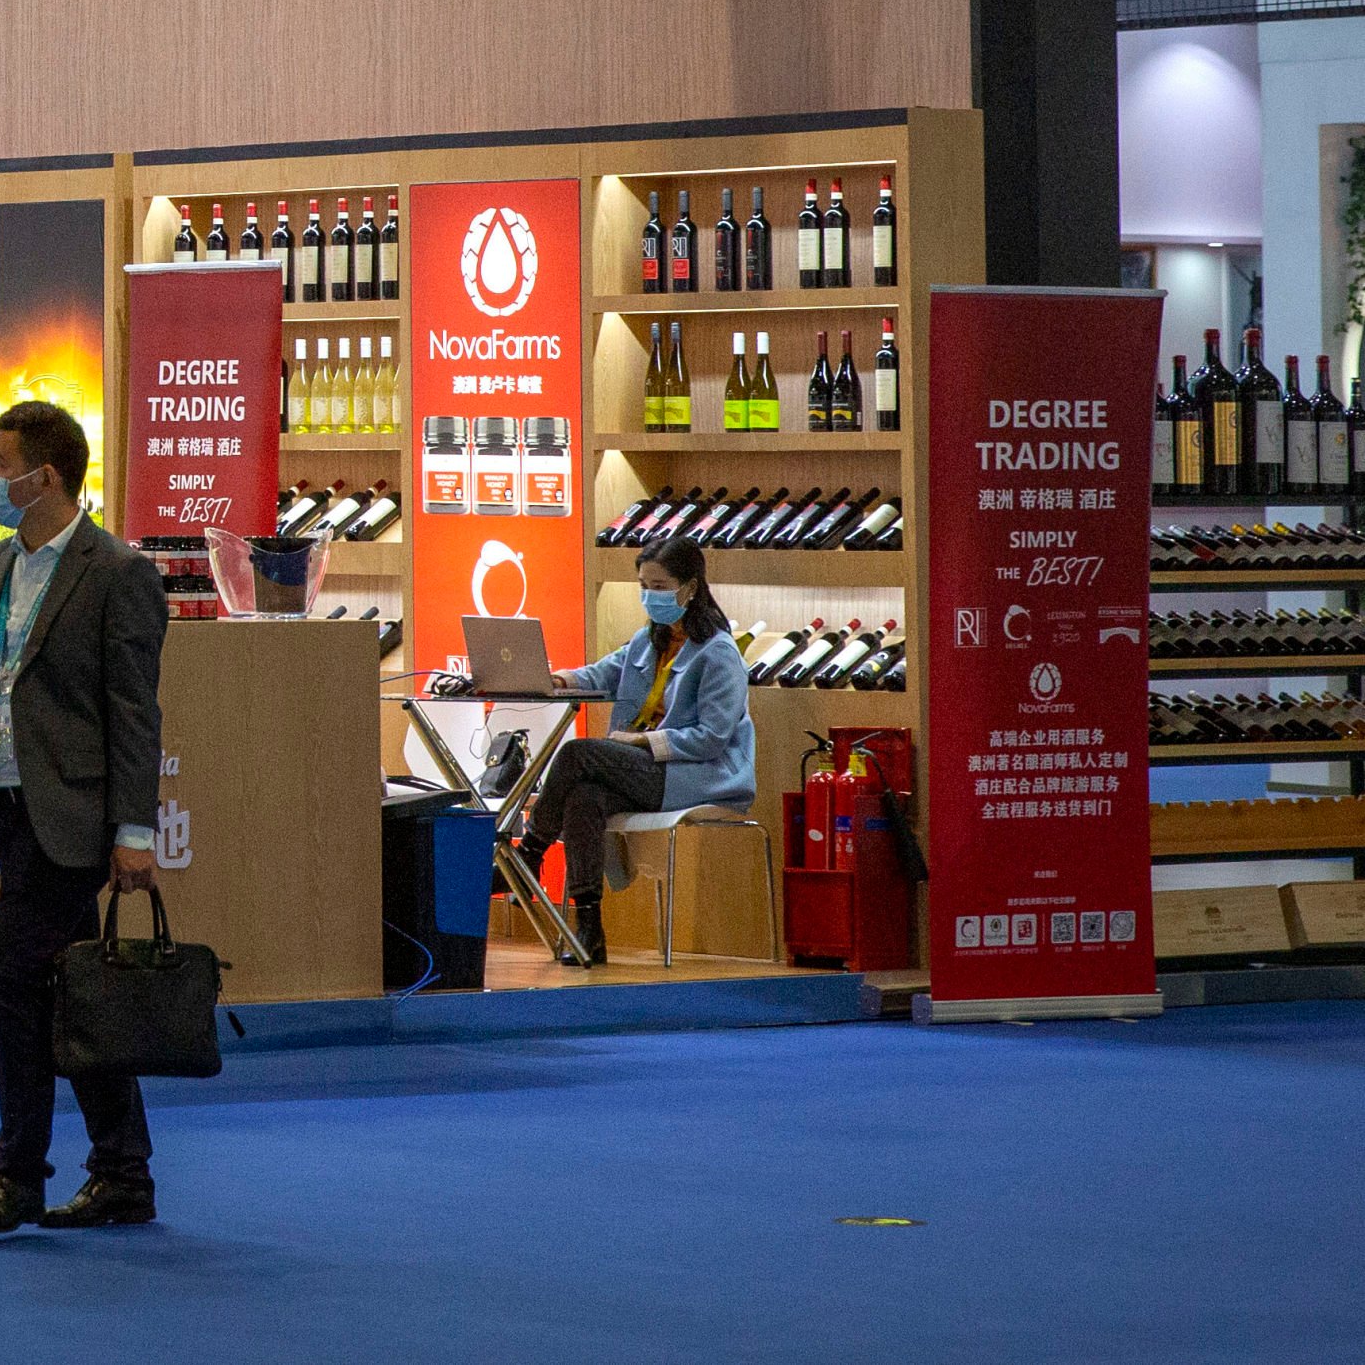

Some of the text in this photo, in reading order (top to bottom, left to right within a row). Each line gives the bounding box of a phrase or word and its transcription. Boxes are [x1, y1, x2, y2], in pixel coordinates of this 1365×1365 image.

[428, 328, 561, 360] NovaFarms
[158, 359, 239, 386] DEGREE
[147, 396, 246, 423] TRADING
[988, 400, 1108, 429] DEGREE
[147, 436, 242, 457] 澳洲 帝格瑞 酒庄
[975, 441, 1121, 471] TRADING
[168, 473, 216, 493] SIMPLY
[157, 497, 232, 524] THE BEST!
[978, 488, 1117, 511] 澳洲 帝格瑞 酒庄
[1009, 530, 1077, 549] SIMPLY
[996, 556, 1104, 587] THE BEST!
[1018, 701, 1076, 714] NovaFarms
[989, 728, 1106, 748] 高端企业用酒服务
[968, 751, 1129, 772] 澳洲著名酿酒师私人定制
[975, 775, 1120, 796] 酒庄配合品牌旅游服务
[981, 799, 1112, 820] 全流程服务送货到门
